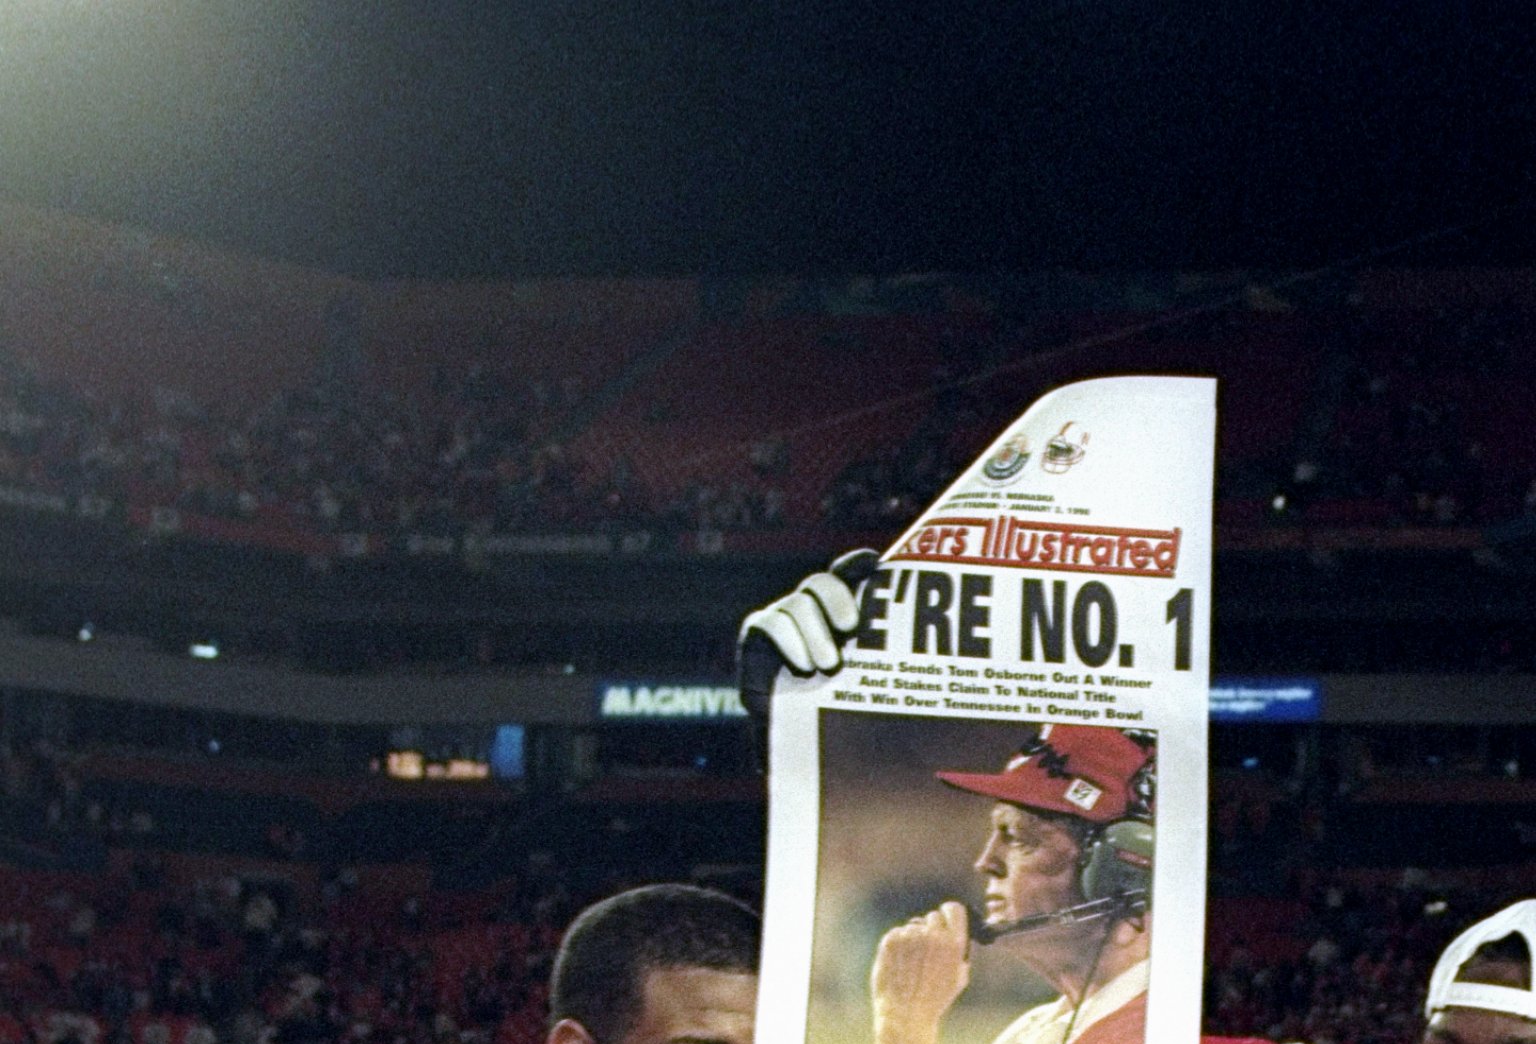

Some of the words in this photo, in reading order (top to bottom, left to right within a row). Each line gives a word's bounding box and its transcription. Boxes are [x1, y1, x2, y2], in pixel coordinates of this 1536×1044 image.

[981, 515, 1182, 574] Illustrated
[856, 568, 994, 659] E'RE
[1020, 577, 1135, 668] NO.
[1166, 587, 1195, 672] 1
[860, 675, 888, 689] And
[893, 678, 943, 692] Stakes
[948, 682, 990, 695] Claim
[994, 684, 1011, 697] To
[1017, 686, 1079, 701] National
[1084, 690, 1117, 704] Title
[898, 661, 943, 676] Sends
[948, 665, 978, 678] Tom
[984, 667, 1046, 683] Osborne
[1052, 671, 1079, 685] Out
[1084, 673, 1095, 686] A
[1100, 675, 1153, 689] Winner
[834, 689, 866, 703] With
[870, 692, 899, 705] Win
[903, 695, 939, 708] Over
[943, 697, 1021, 714] Tennessee
[1047, 704, 1100, 720] Orange
[1105, 708, 1144, 721] Bowl
